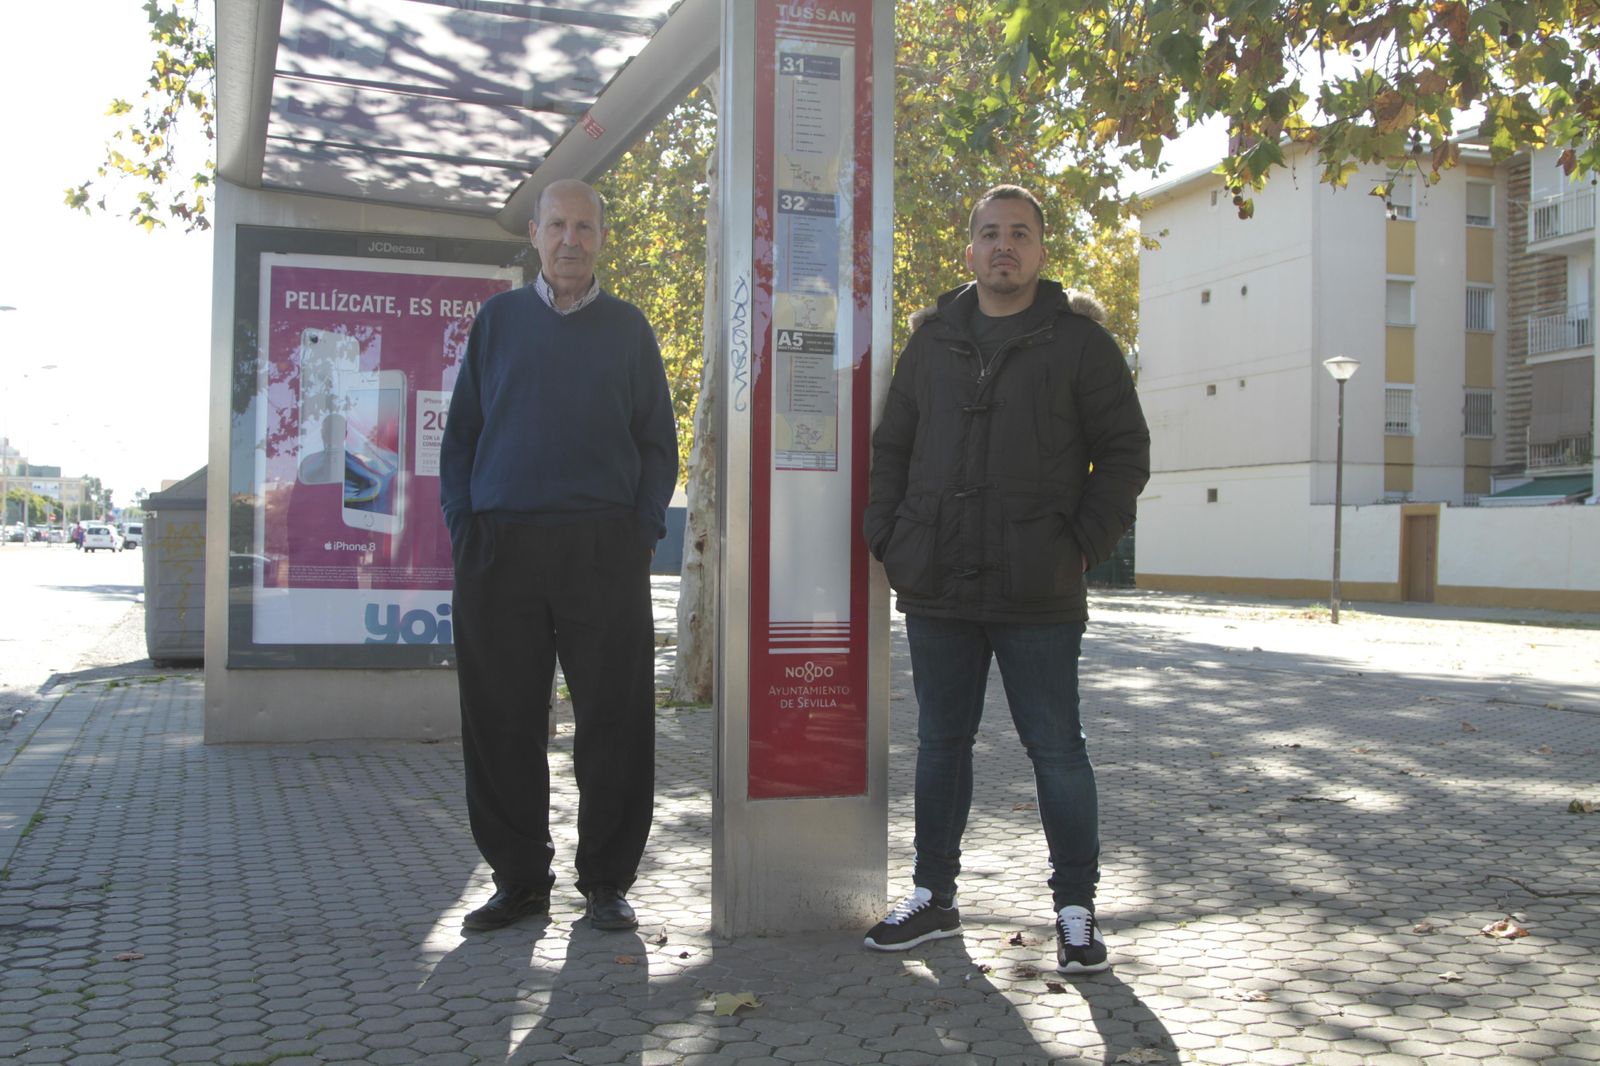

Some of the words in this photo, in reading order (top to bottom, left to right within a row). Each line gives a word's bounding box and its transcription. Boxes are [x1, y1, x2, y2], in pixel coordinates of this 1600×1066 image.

[776, 4, 857, 24] TUSSAM
[783, 56, 805, 73] 31
[781, 194, 805, 211] 32
[368, 241, 425, 255] JCDecaux
[285, 289, 402, 318] PELLÍZCATE,
[409, 297, 432, 316] ES
[778, 331, 804, 347] A5
[333, 540, 366, 552] iPhone
[368, 541, 376, 552] 8
[768, 685, 850, 697] AYUNTAMIENTO
[780, 698, 795, 709] DE
[797, 696, 837, 708] SEVILLA
